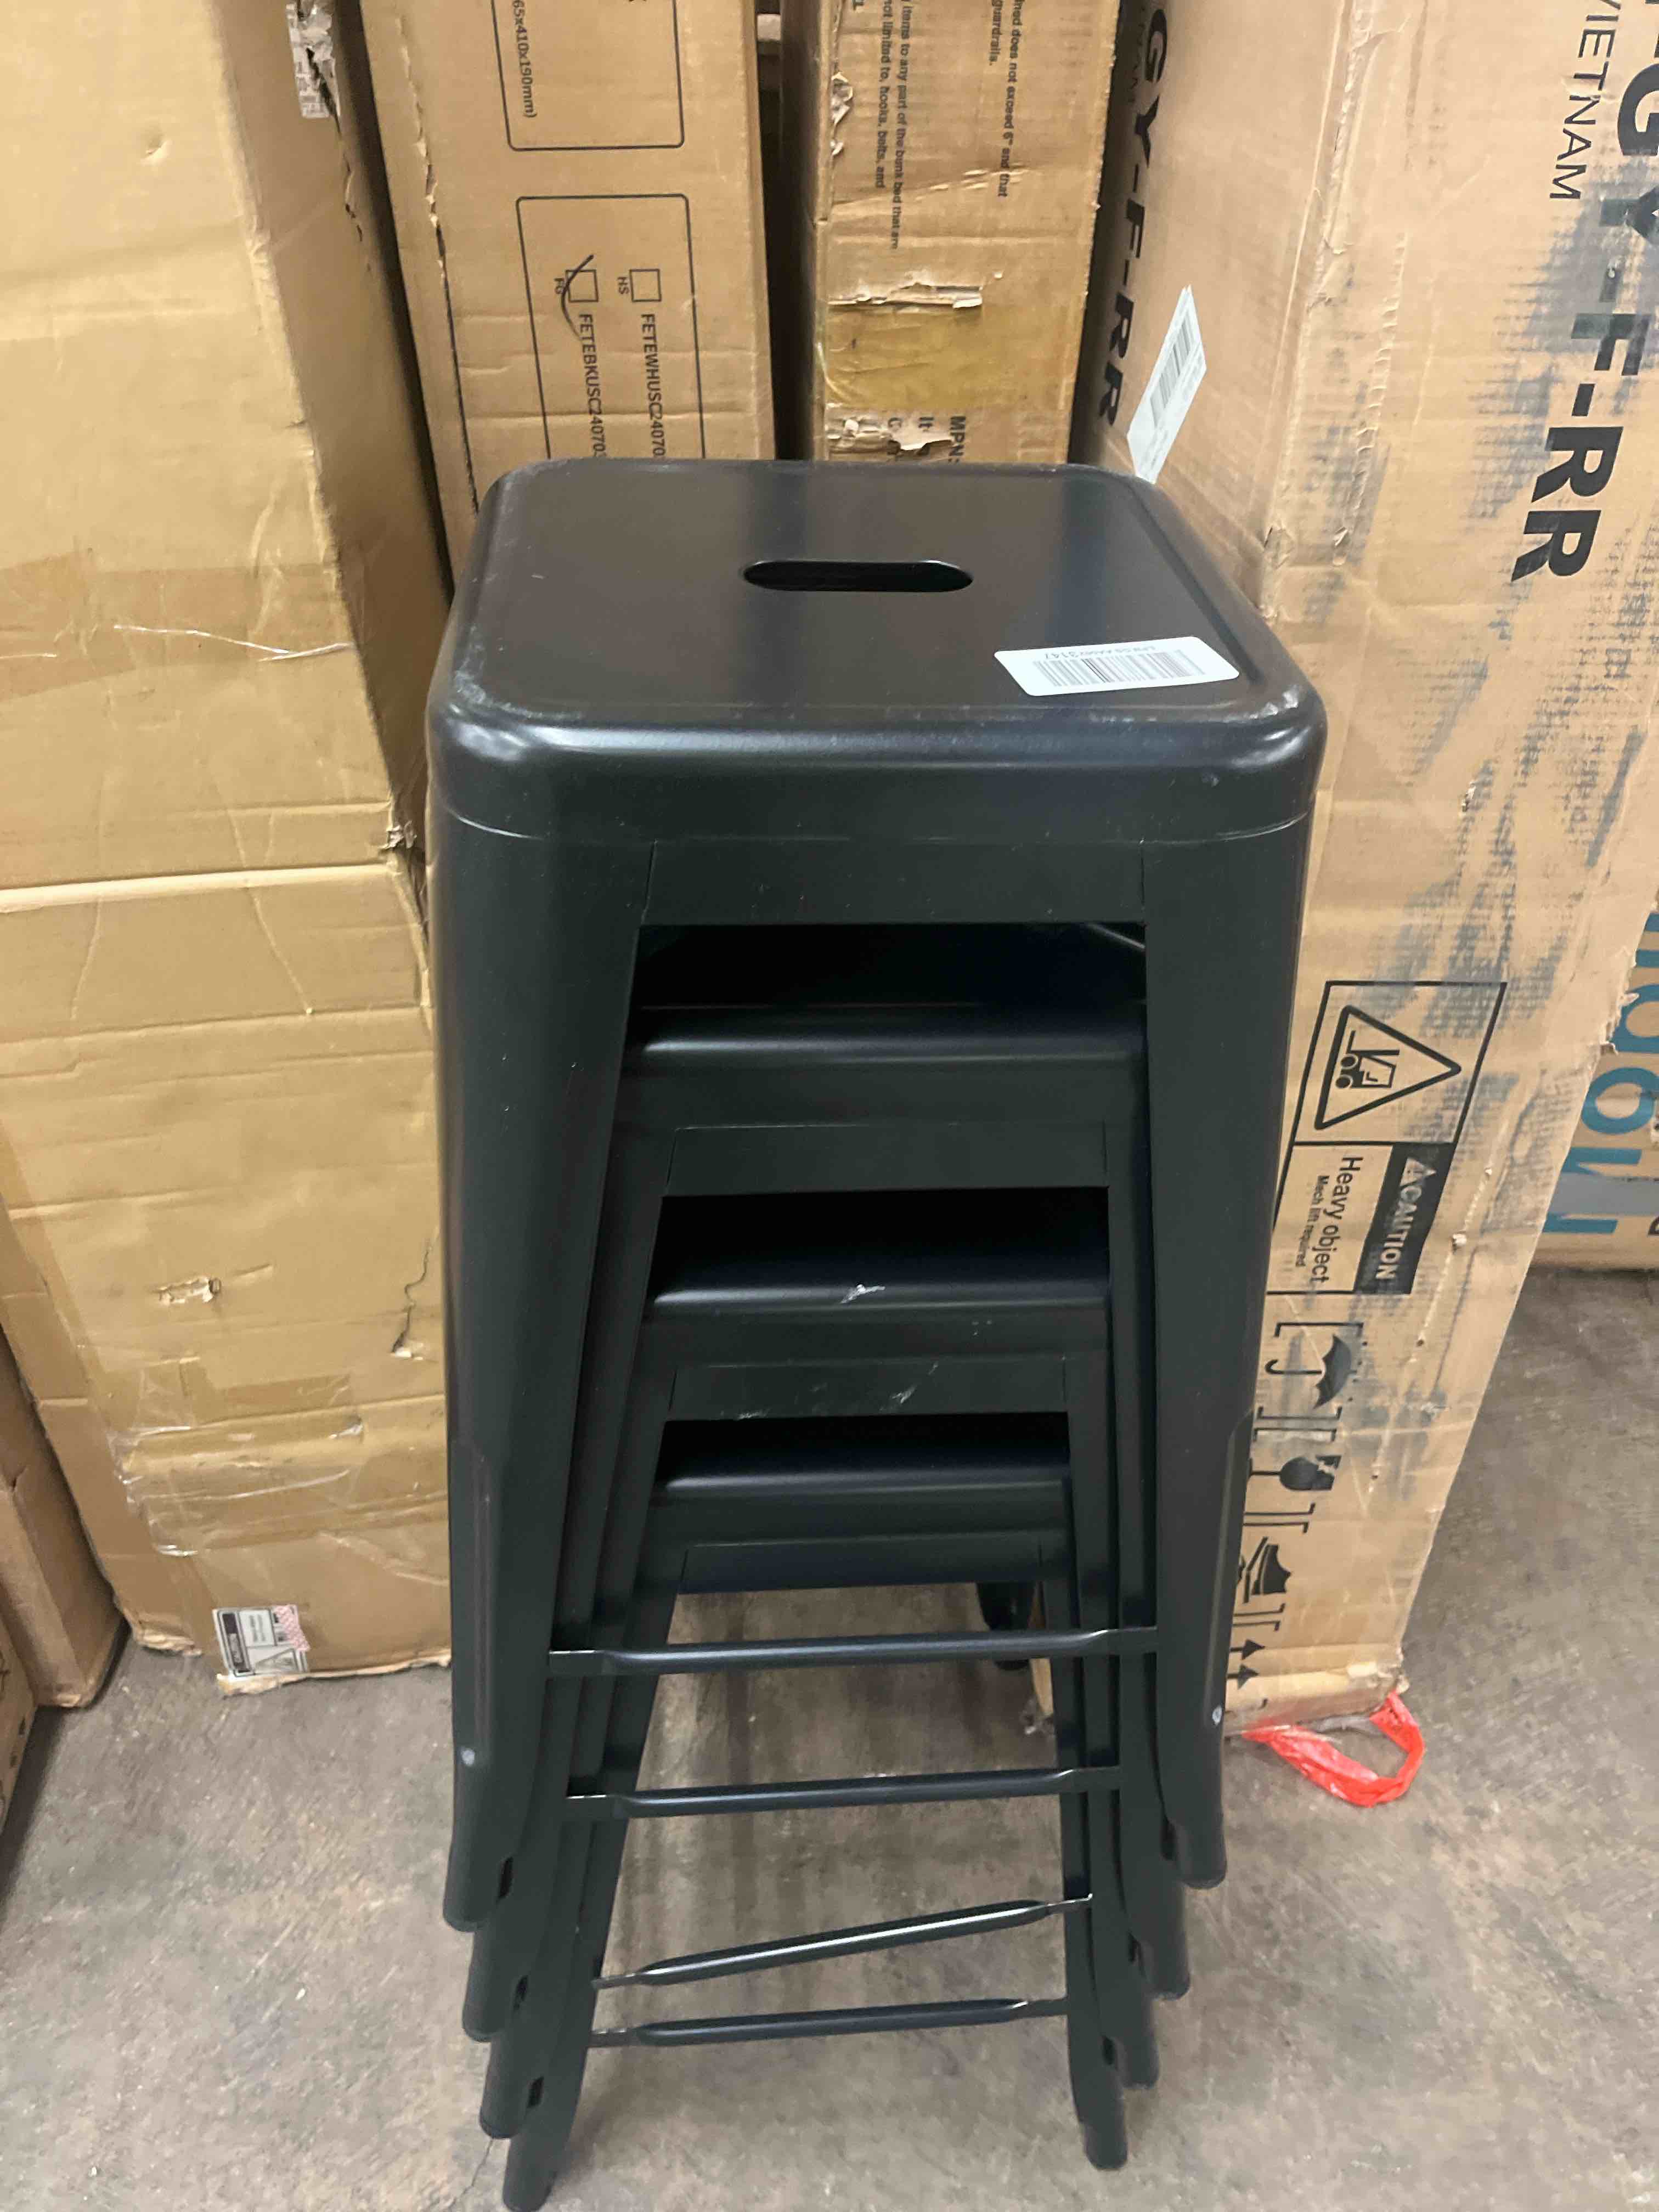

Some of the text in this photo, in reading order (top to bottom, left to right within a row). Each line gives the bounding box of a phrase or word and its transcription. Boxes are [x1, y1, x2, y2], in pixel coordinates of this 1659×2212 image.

[881, 21, 893, 63] limited
[900, 43, 910, 55] to
[1009, 29, 1022, 59] does
[896, 59, 909, 81] any
[1007, 63, 1018, 82] not
[896, 84, 907, 109] part
[1003, 86, 1015, 128] exceed
[896, 112, 907, 125] of
[895, 128, 906, 147] the
[894, 150, 905, 178] bunk
[1000, 148, 1011, 168] and
[875, 166, 886, 188] and
[997, 173, 1011, 197] that
[892, 182, 903, 203] bed
[891, 206, 902, 228] that
[617, 276, 630, 295] HS
[1310, 1156, 1363, 1283] Heavy object
[1375, 1184, 1423, 1280] CAUTION
[1295, 1225, 1314, 1268] required
